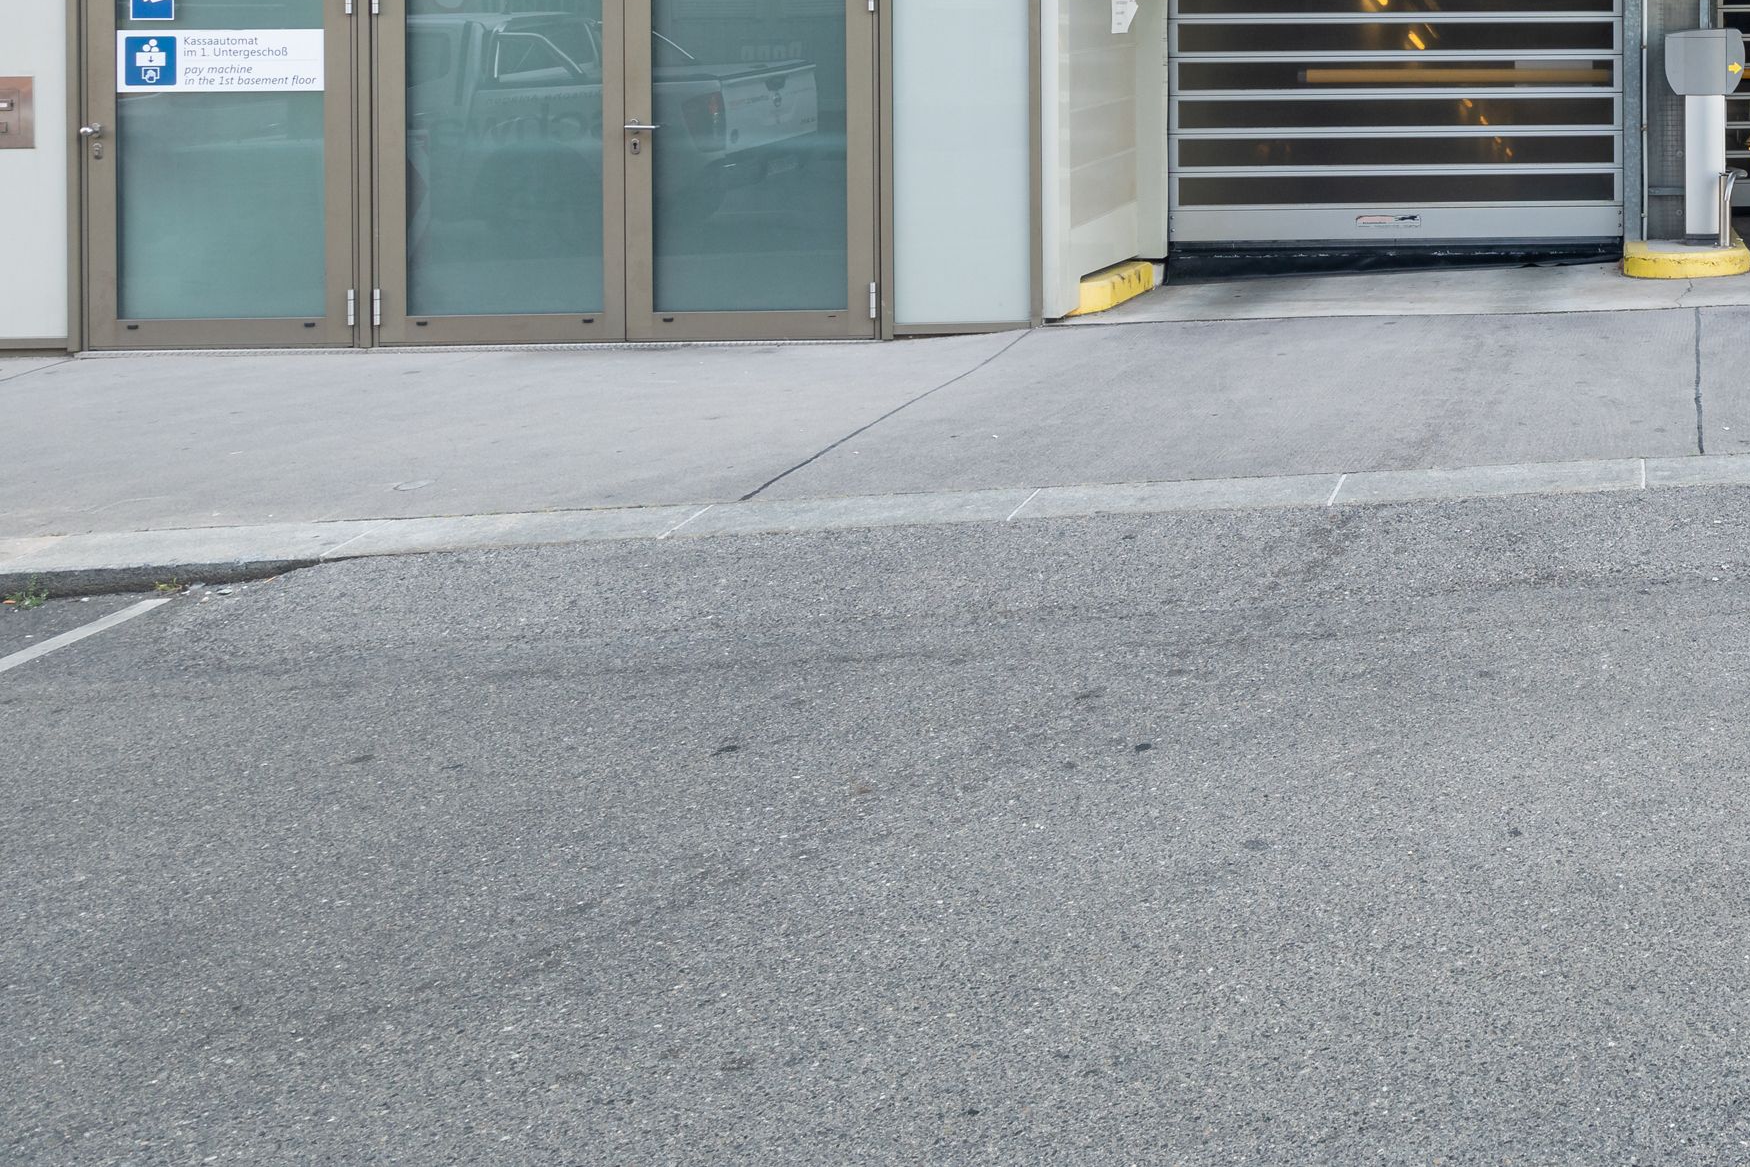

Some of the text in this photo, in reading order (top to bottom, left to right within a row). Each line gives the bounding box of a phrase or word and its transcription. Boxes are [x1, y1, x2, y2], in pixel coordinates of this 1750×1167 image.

[183, 36, 259, 46] Kassaautomat
[183, 47, 288, 59] im 1. Untergeschoß
[184, 65, 253, 76] pay machine
[184, 75, 317, 86] in the 1st basement floor
